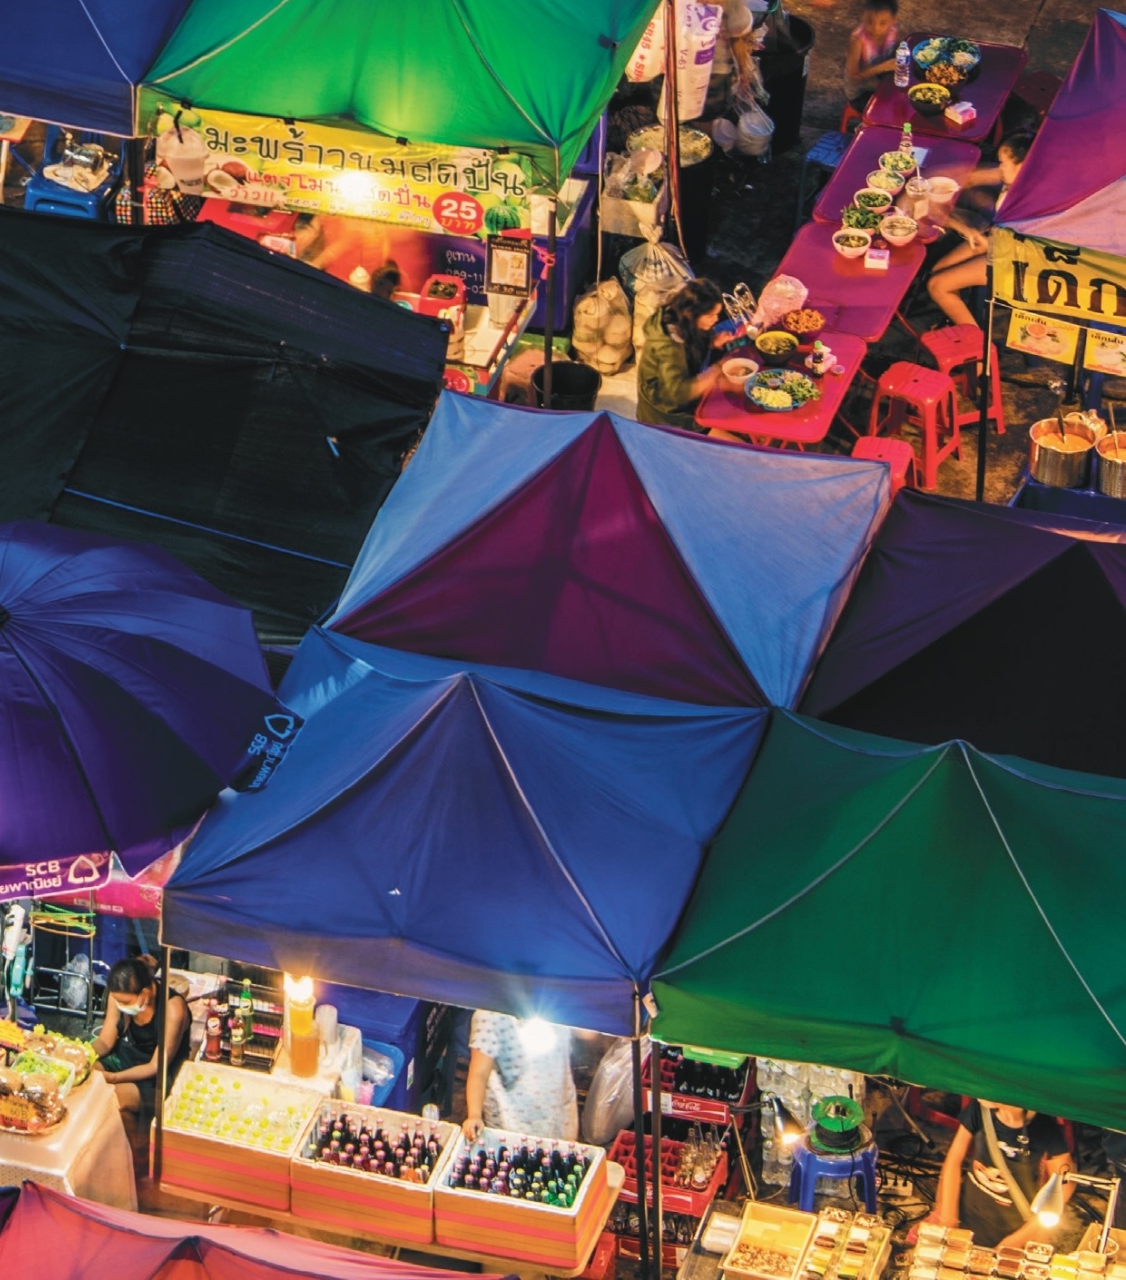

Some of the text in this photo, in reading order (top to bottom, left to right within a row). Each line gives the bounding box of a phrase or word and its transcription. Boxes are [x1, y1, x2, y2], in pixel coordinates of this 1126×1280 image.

[205, 127, 526, 197] มะพร้าวนมสดปั่น
[441, 199, 477, 220] 25
[440, 217, 476, 230] บาท
[247, 733, 268, 755] SCB
[25, 860, 61, 877] SCB
